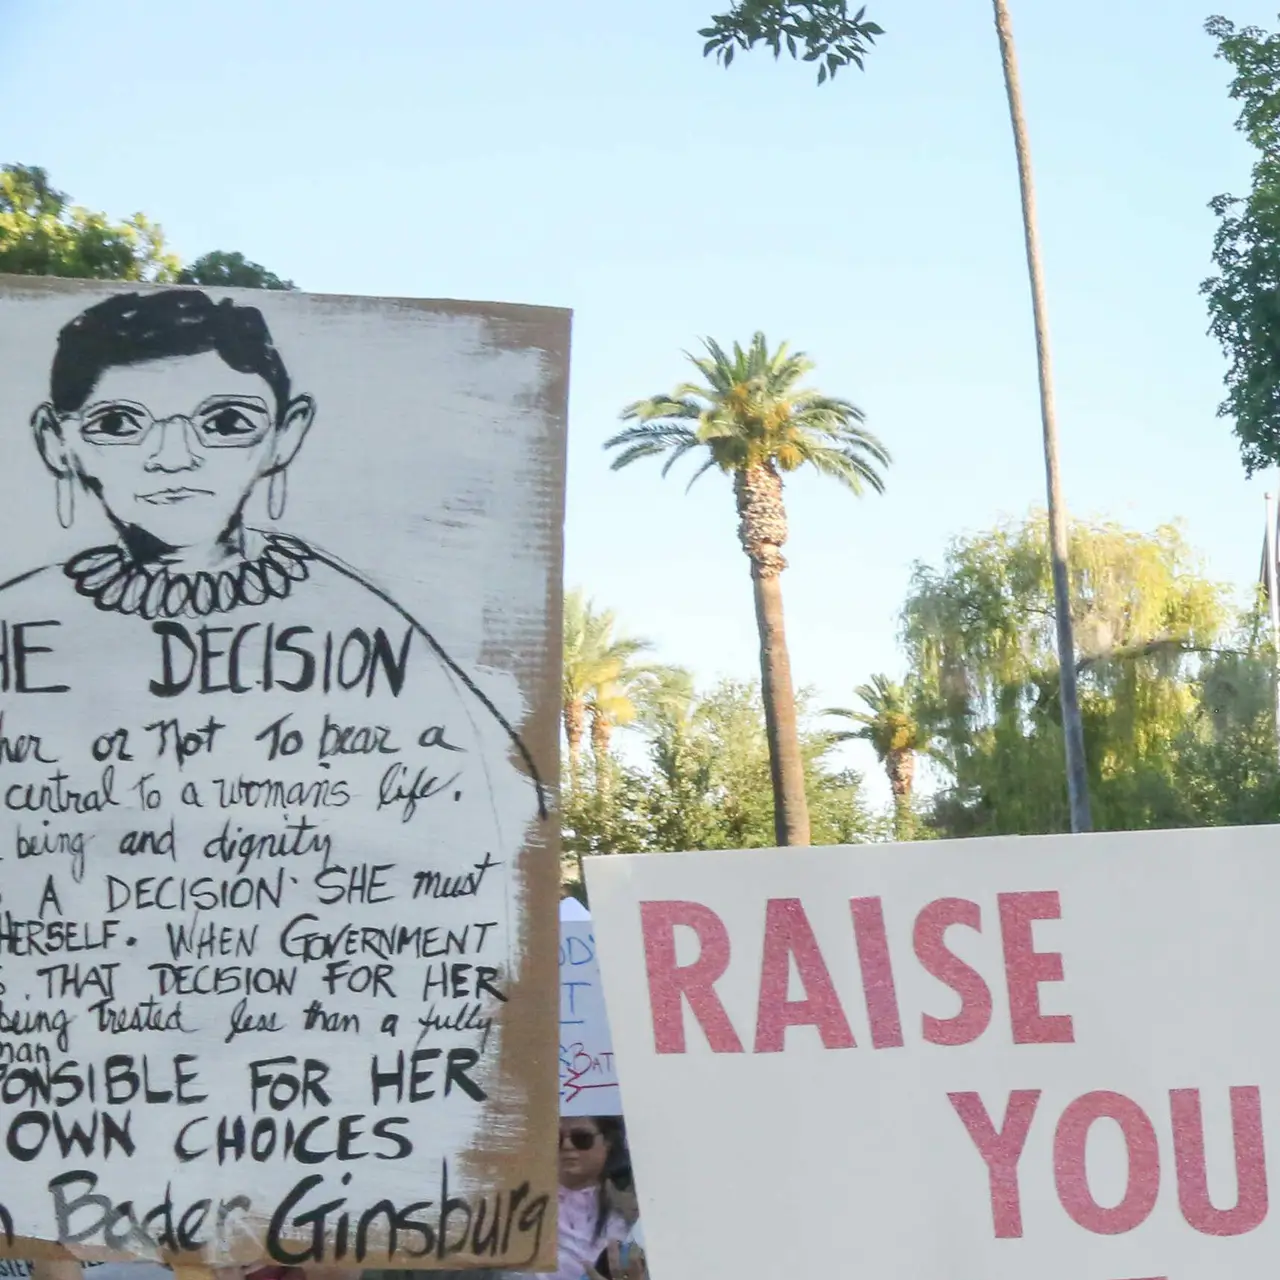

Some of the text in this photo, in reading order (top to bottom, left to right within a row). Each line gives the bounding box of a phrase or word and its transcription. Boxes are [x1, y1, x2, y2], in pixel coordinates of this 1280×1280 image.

[150, 620, 413, 698] DECISION
[418, 724, 469, 753] a
[181, 782, 204, 808] a
[17, 814, 333, 884] being and dignity
[39, 852, 505, 918] A DECISION SHE must
[167, 910, 259, 960] WHEN
[280, 913, 497, 959] GOVERNMENT
[38, 962, 121, 1001] THAT
[148, 963, 297, 996] DECISION
[322, 961, 395, 997] FOR
[423, 962, 509, 1001] HER
[640, 890, 1076, 1055] RAISE
[303, 1000, 361, 1034] than
[380, 1013, 398, 1037] a
[250, 1056, 330, 1112] FOR
[371, 1047, 487, 1104] HER
[6, 1109, 413, 1166] OWN CHOICES
[48, 1169, 251, 1254] Bader
[266, 1157, 549, 1266] Ginsburg
